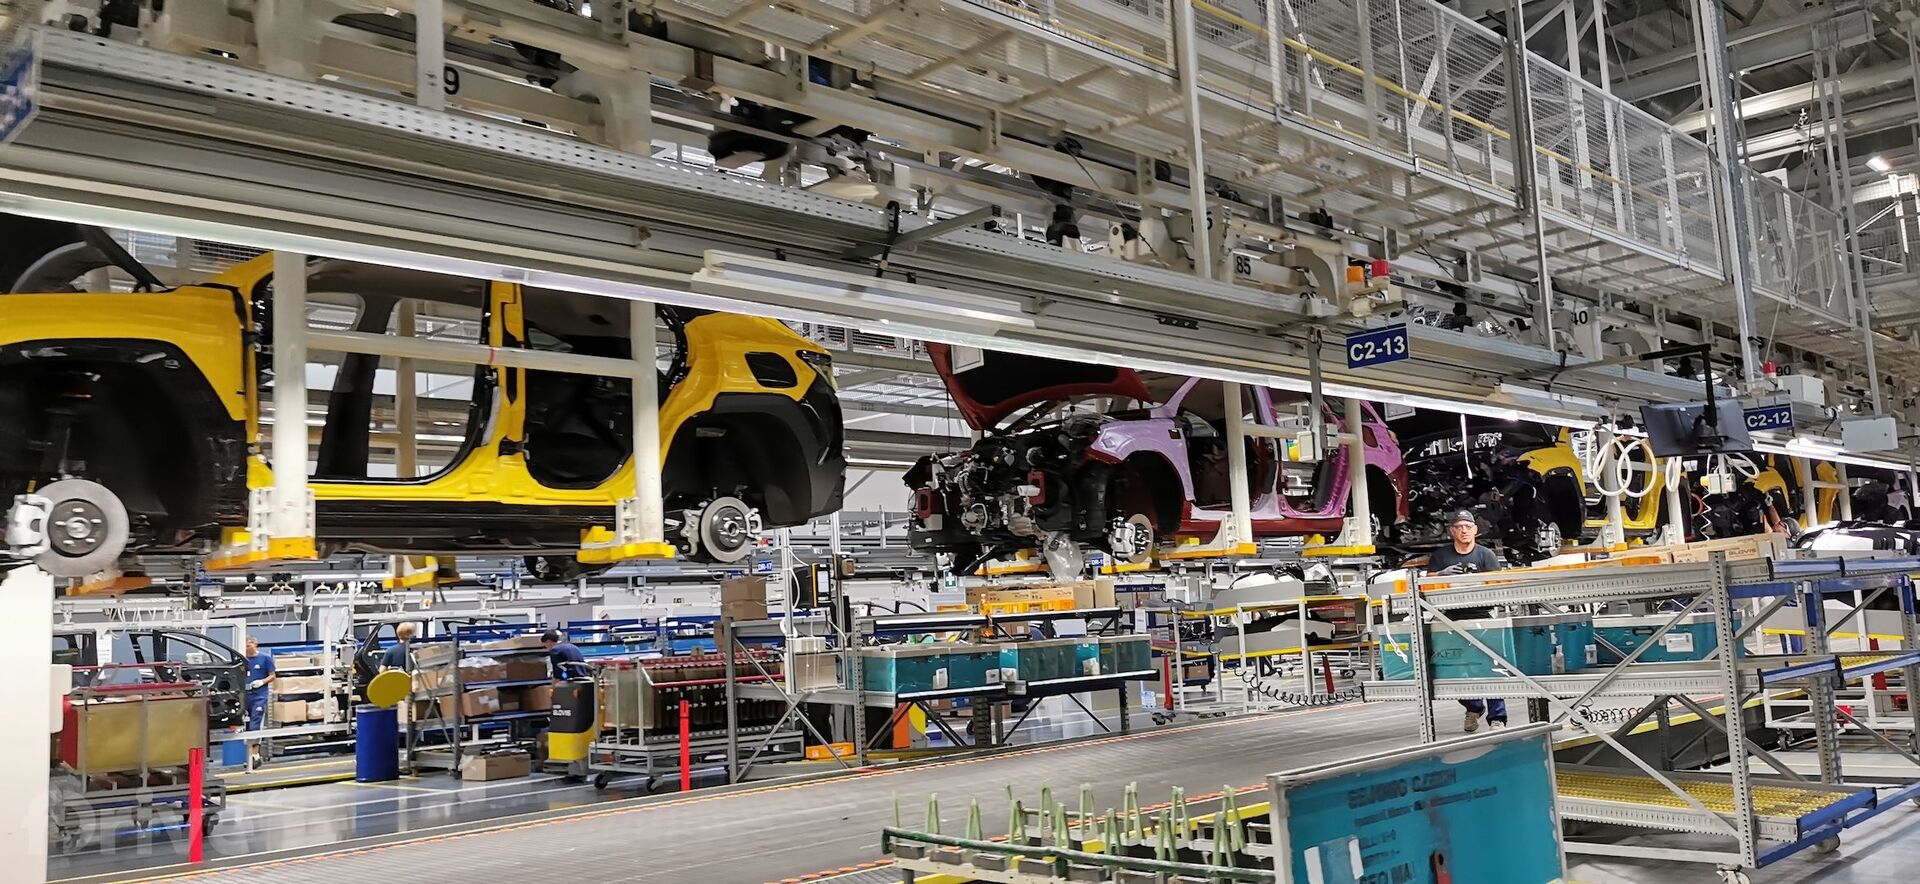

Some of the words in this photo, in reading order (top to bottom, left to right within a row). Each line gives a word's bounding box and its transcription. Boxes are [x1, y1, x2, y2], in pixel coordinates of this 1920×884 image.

[1236, 256, 1251, 275] 85
[1350, 336, 1406, 361] C2-13
[1747, 411, 1791, 427] C2-12
